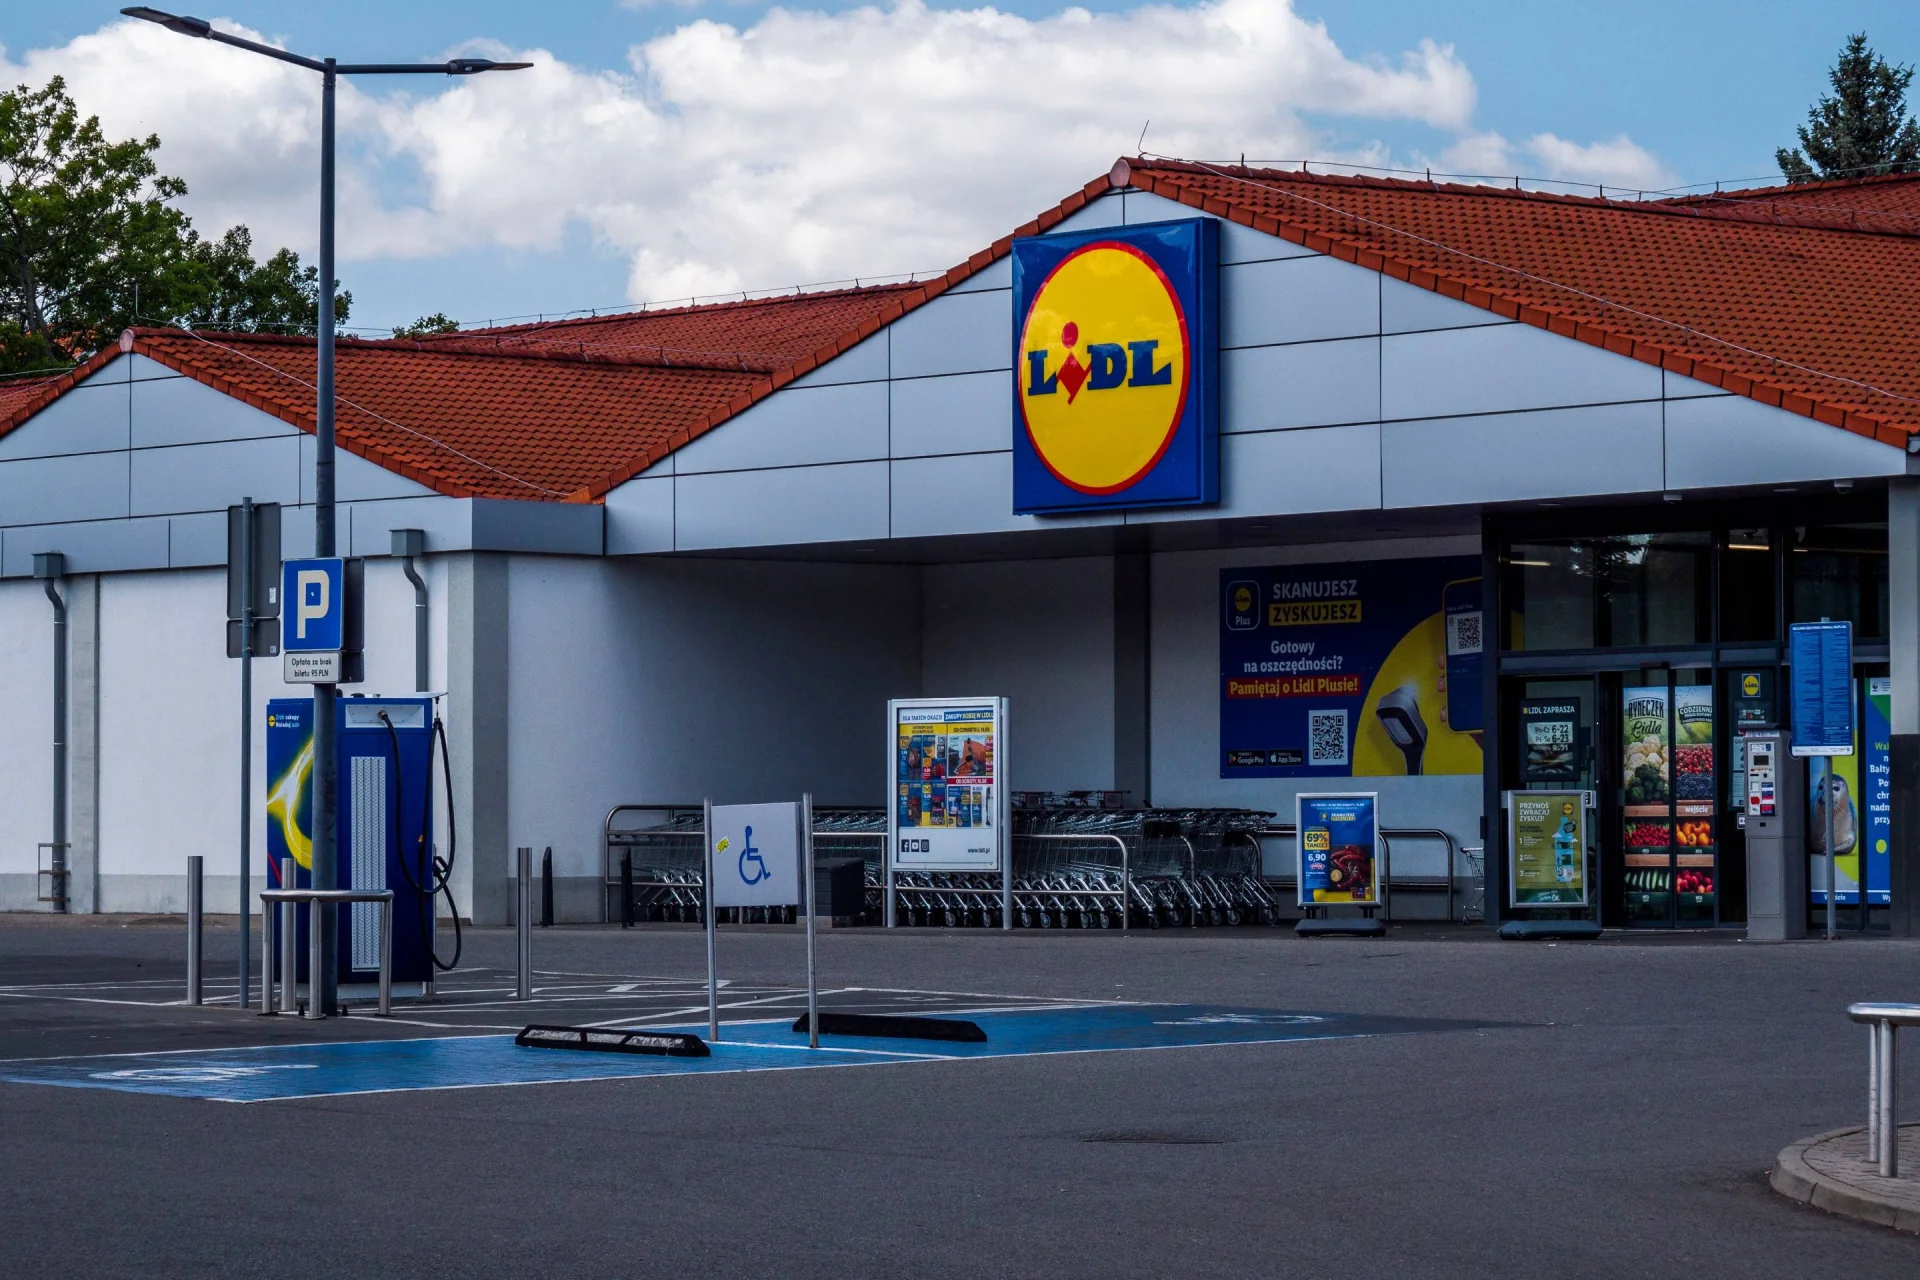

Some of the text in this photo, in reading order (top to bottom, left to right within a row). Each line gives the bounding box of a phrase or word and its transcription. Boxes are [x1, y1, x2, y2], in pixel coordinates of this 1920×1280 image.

[1028, 322, 1172, 405] LIDL
[1273, 580, 1358, 599] SKANUJESZ
[297, 570, 329, 638] P
[1235, 616, 1251, 626] Plus
[1273, 604, 1358, 622] ZYSKUJESZ
[1271, 640, 1315, 656] Gotowy
[292, 658, 310, 668] Opłata
[1244, 656, 1344, 674] na oszczędności?
[295, 669, 310, 677] biletu
[311, 669, 318, 677] 95
[1229, 677, 1359, 698] Pamiętaj o Lidl Plusie!
[1528, 705, 1575, 714] LIDL ZAPRASZA
[1628, 700, 1664, 719] RYNECZEK
[1631, 720, 1663, 739] Lidla
[1238, 756, 1264, 765] Google Play
[1685, 805, 1708, 814] wejście
[1307, 833, 1328, 843] 69%
[1308, 853, 1326, 862] 6,90
